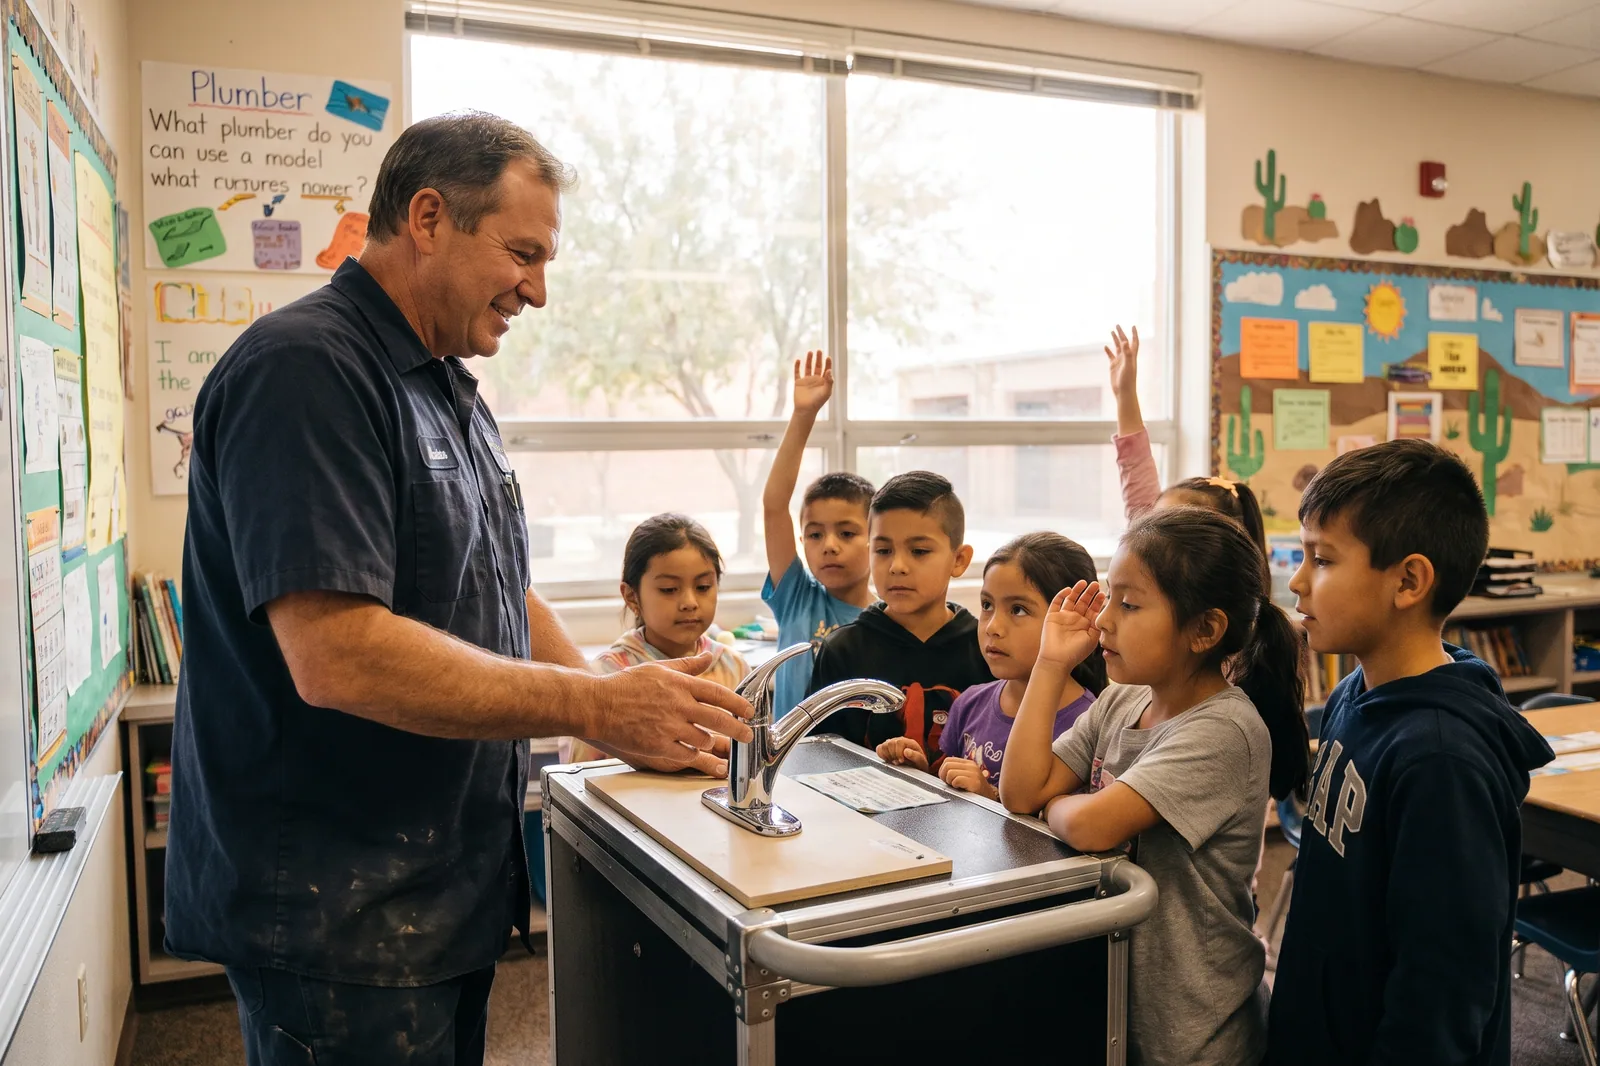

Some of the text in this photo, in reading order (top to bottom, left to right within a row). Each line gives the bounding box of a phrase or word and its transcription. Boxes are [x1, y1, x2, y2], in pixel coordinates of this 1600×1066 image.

[192, 70, 312, 111] Plumber
[149, 108, 373, 153] What plumber do you
[149, 143, 323, 169] can use a model
[151, 166, 200, 189] what
[154, 340, 217, 365] I am
[157, 369, 192, 391] the
